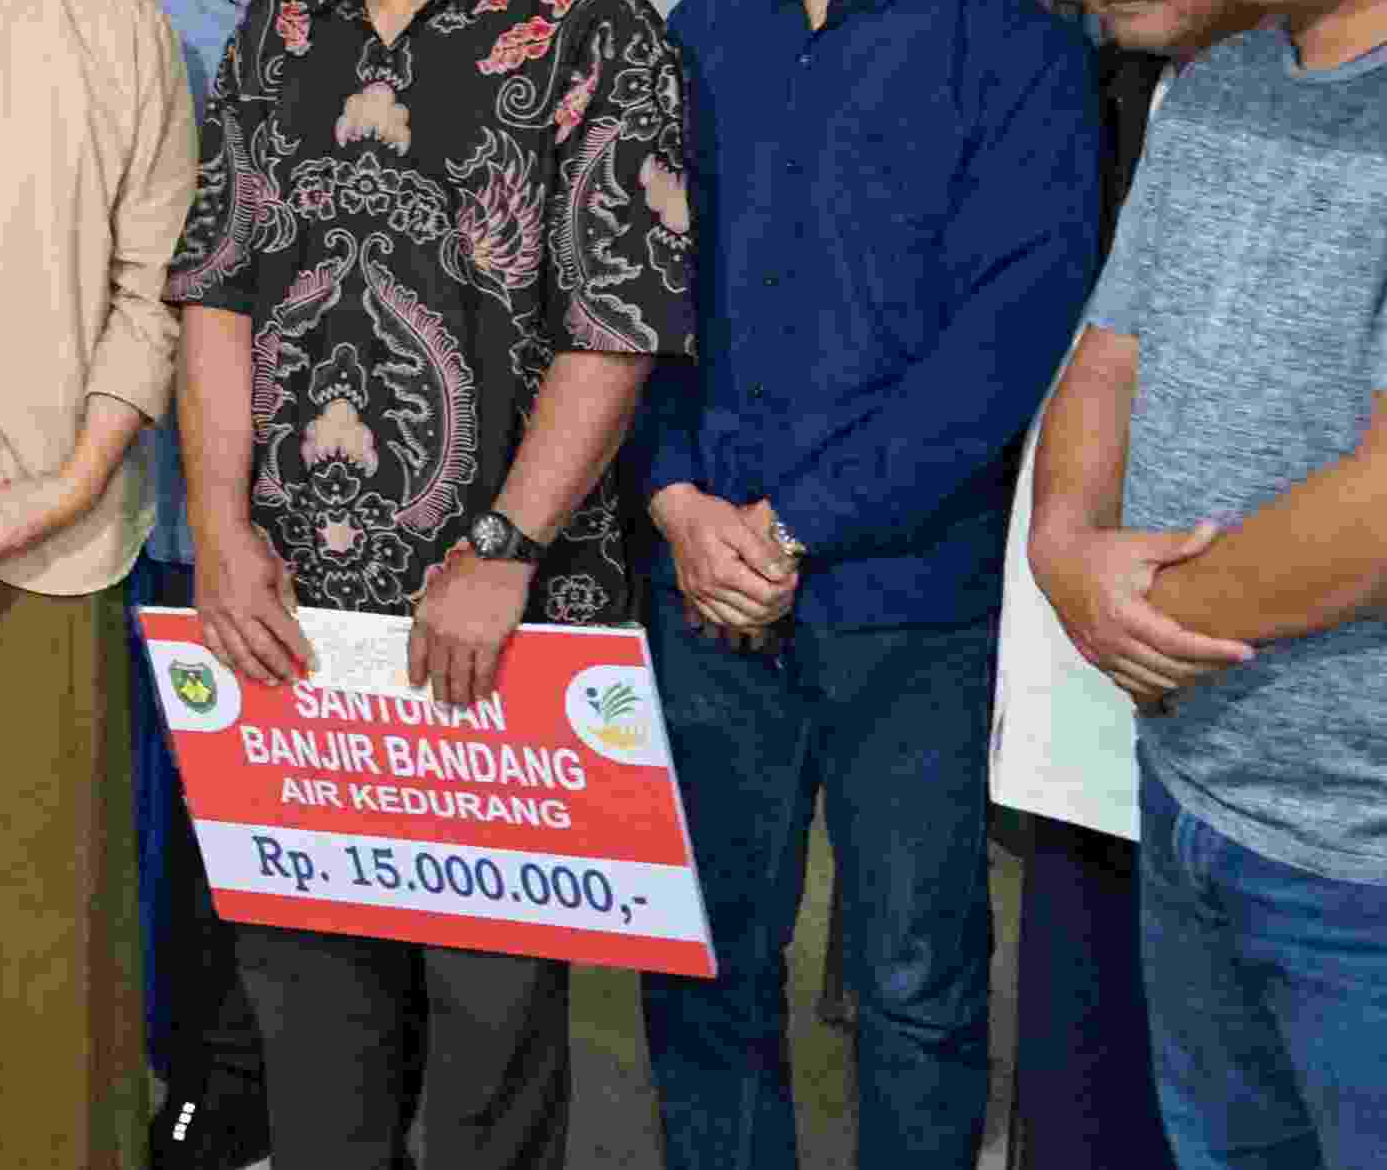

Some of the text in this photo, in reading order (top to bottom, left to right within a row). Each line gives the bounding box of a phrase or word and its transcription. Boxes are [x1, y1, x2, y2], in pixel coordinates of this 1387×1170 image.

[241, 724, 379, 776] BANJIR
[386, 736, 587, 791] BANDANG
[280, 776, 573, 831] AIR KEDURANG
[251, 833, 648, 924] Rp. 15.000.000,-
